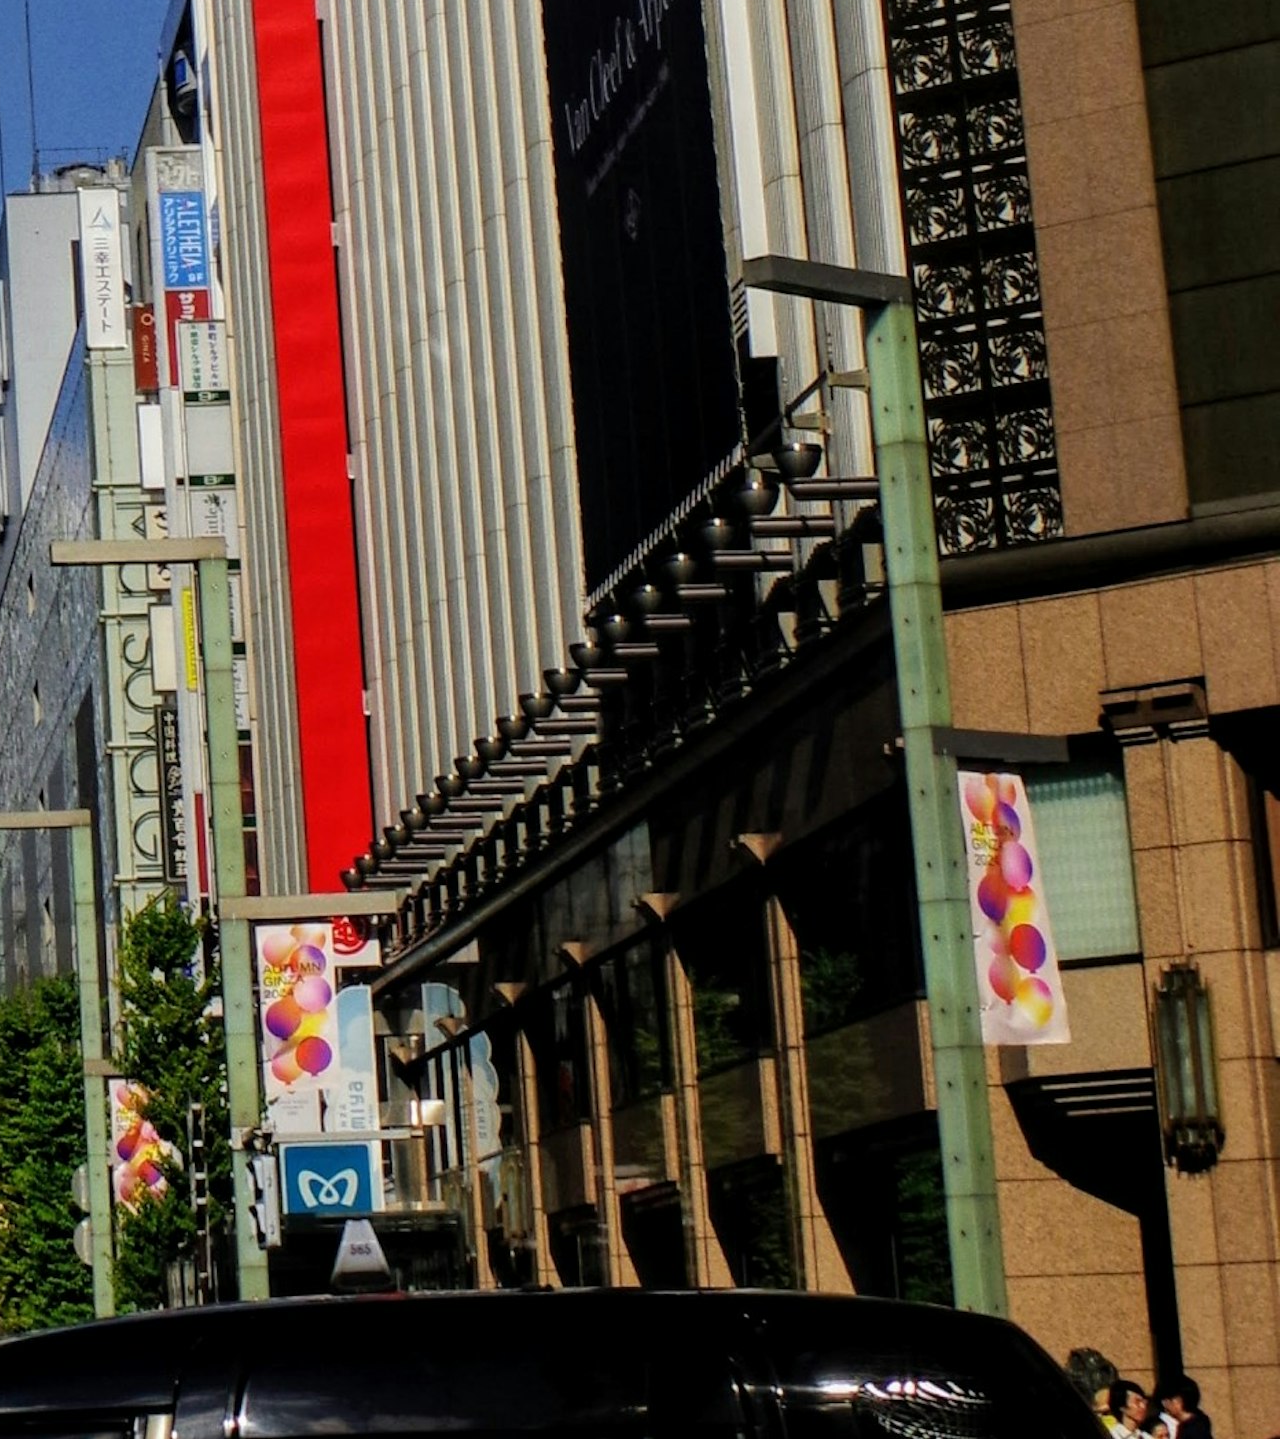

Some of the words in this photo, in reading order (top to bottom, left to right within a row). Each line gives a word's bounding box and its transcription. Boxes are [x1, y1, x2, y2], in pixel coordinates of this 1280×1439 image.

[564, 88, 591, 153] Van
[588, 16, 624, 123] Cleef
[176, 198, 203, 269] ALETHEIA
[94, 237, 113, 333] 三幸エステート
[263, 961, 321, 975] AUTUMN
[263, 974, 306, 988] GINZA
